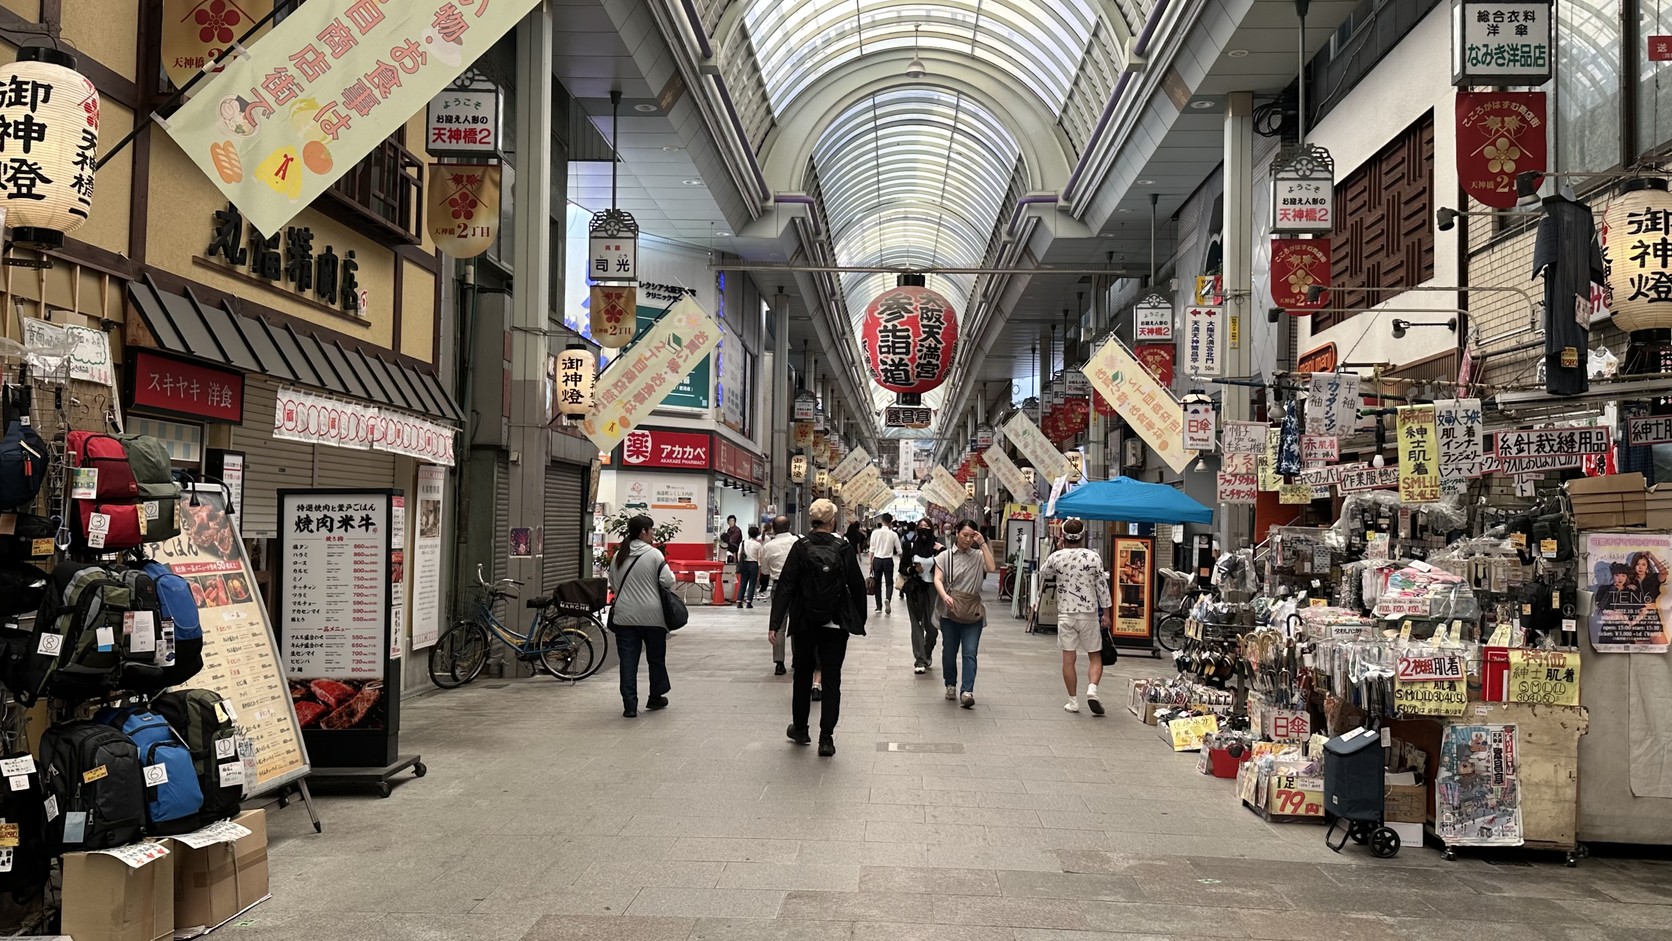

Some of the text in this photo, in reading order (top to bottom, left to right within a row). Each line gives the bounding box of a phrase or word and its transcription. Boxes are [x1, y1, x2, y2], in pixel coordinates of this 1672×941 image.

[1477, 11, 1536, 23] 総合衣料
[1487, 24, 1528, 36] 洋傘
[1467, 43, 1546, 68] なみき洋品店
[443, 98, 482, 110] ようこそ
[436, 115, 488, 125] お迎え人形の
[432, 127, 491, 145] 天神橋2
[1288, 184, 1320, 194] ようこそ
[1282, 198, 1326, 206] お迎え人形の
[1279, 208, 1328, 222] 天神橋2
[434, 222, 490, 239] 天神橋2丁目
[873, 292, 918, 387] 参詣道
[914, 292, 946, 380] 大阪天満宮
[1139, 326, 1170, 336] 天神橋2
[562, 357, 584, 405] 御神燈
[148, 372, 232, 408] スキヤキ 洋食
[1310, 380, 1323, 407] 長袖
[1342, 380, 1356, 409] 半袖
[1188, 418, 1212, 434] 日傘
[627, 432, 650, 460] 薬
[660, 444, 706, 459] アカカベ
[1405, 426, 1431, 475] 紳士肌着
[1443, 439, 1478, 450] インナー
[1343, 471, 1378, 487] 作業服
[294, 513, 378, 534] 焼肉米牛
[1610, 591, 1652, 604] TEN6
[560, 603, 590, 611] MARCHE
[1521, 650, 1567, 668] 特価
[1274, 716, 1308, 737] 日傘
[1276, 790, 1320, 814] 79円
